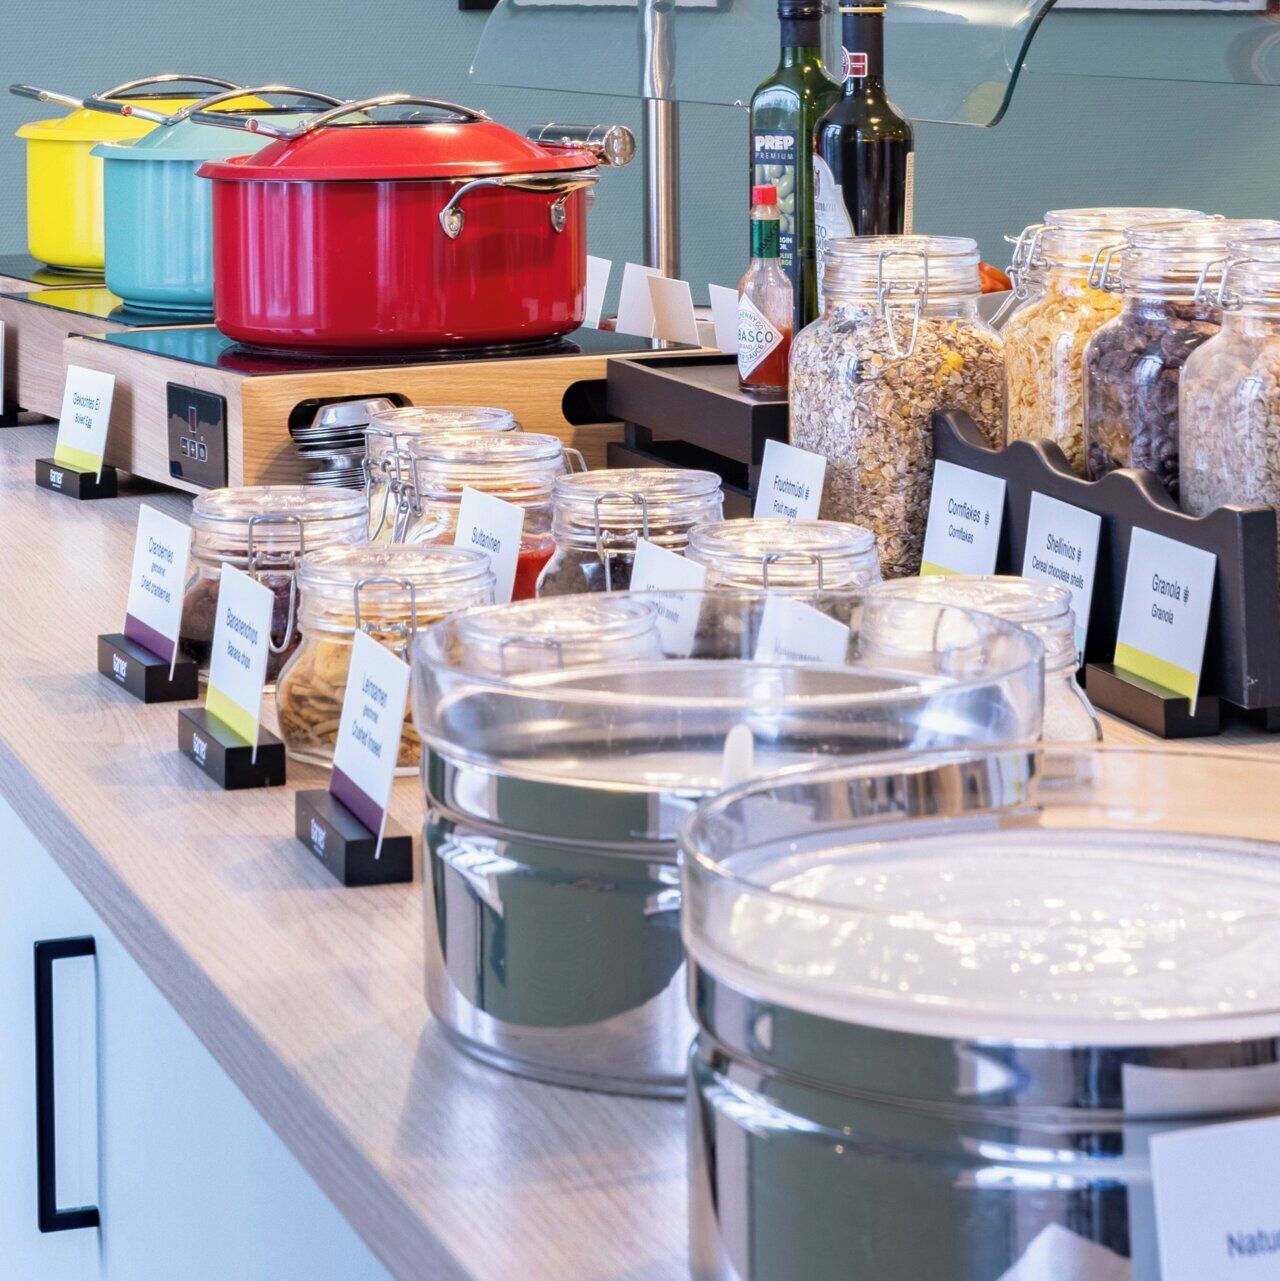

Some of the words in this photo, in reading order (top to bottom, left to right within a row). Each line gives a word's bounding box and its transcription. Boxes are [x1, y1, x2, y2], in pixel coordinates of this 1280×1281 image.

[754, 135, 795, 152] PREP
[755, 152, 794, 161] PREMIUM
[746, 344, 764, 361] SAUCE
[72, 392, 95, 410] Gekochtes
[75, 413, 86, 425] Boiled
[85, 415, 93, 429] Egg
[774, 475, 804, 499] Fruchtmüsli
[773, 499, 784, 514] Fruit
[948, 498, 981, 524] Cornflakes
[472, 526, 500, 553] Sultaninen
[948, 524, 974, 544] Cornflakes
[148, 537, 174, 564] Cranberries
[1032, 555, 1048, 573] Cereal
[1047, 561, 1070, 583] chocolate
[1070, 572, 1084, 590] shells
[1152, 573, 1180, 600] Granola
[1151, 603, 1174, 625] Granola
[226, 608, 258, 645] Bananenchips
[227, 641, 241, 664] Banana
[240, 654, 251, 669] chips
[361, 672, 388, 707] Leinsamen
